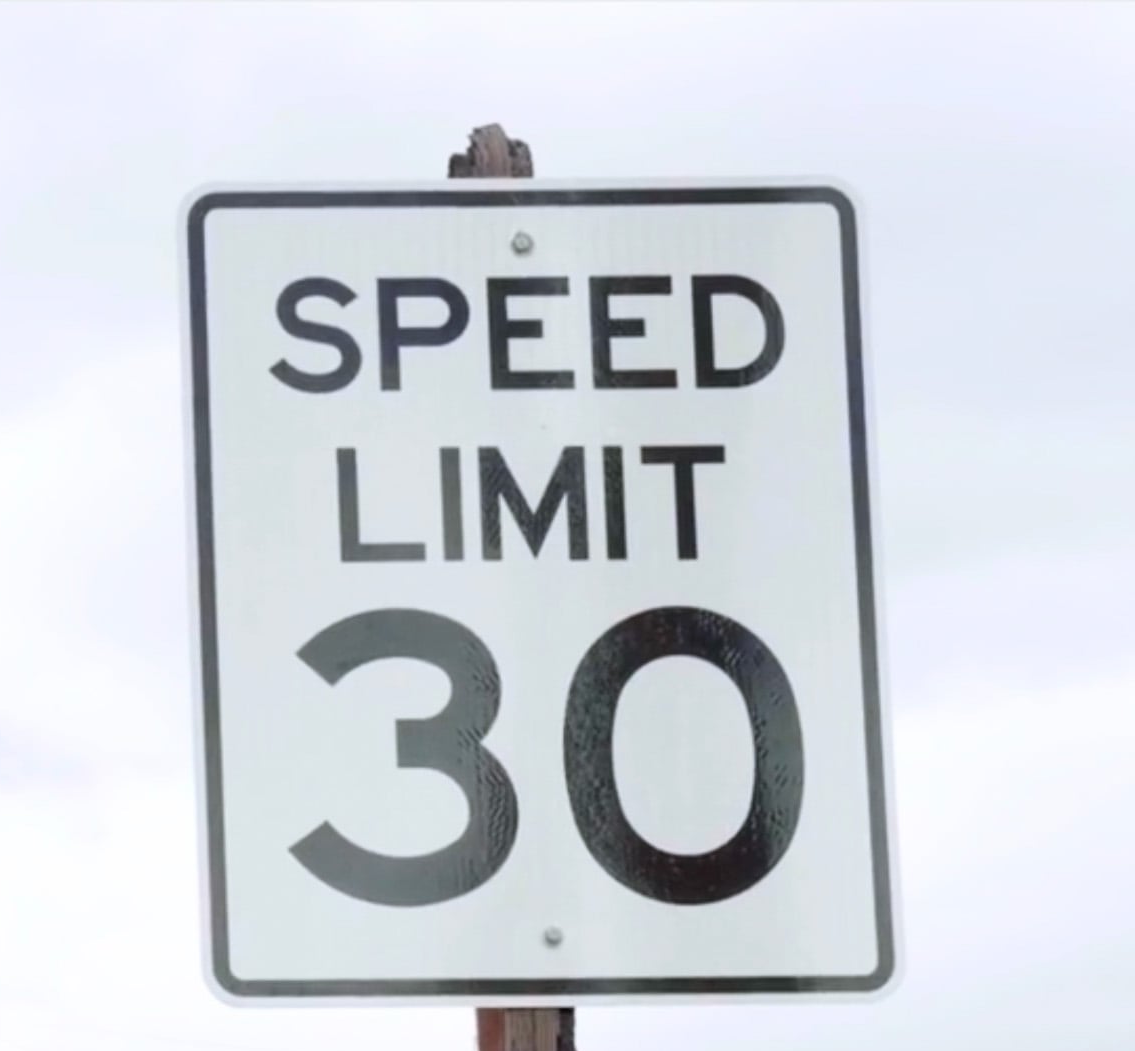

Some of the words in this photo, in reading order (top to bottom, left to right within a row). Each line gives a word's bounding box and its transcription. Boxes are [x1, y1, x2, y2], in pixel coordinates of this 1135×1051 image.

[269, 273, 786, 394] SPEED
[336, 445, 725, 562] LIMIT
[288, 605, 804, 908] 30
